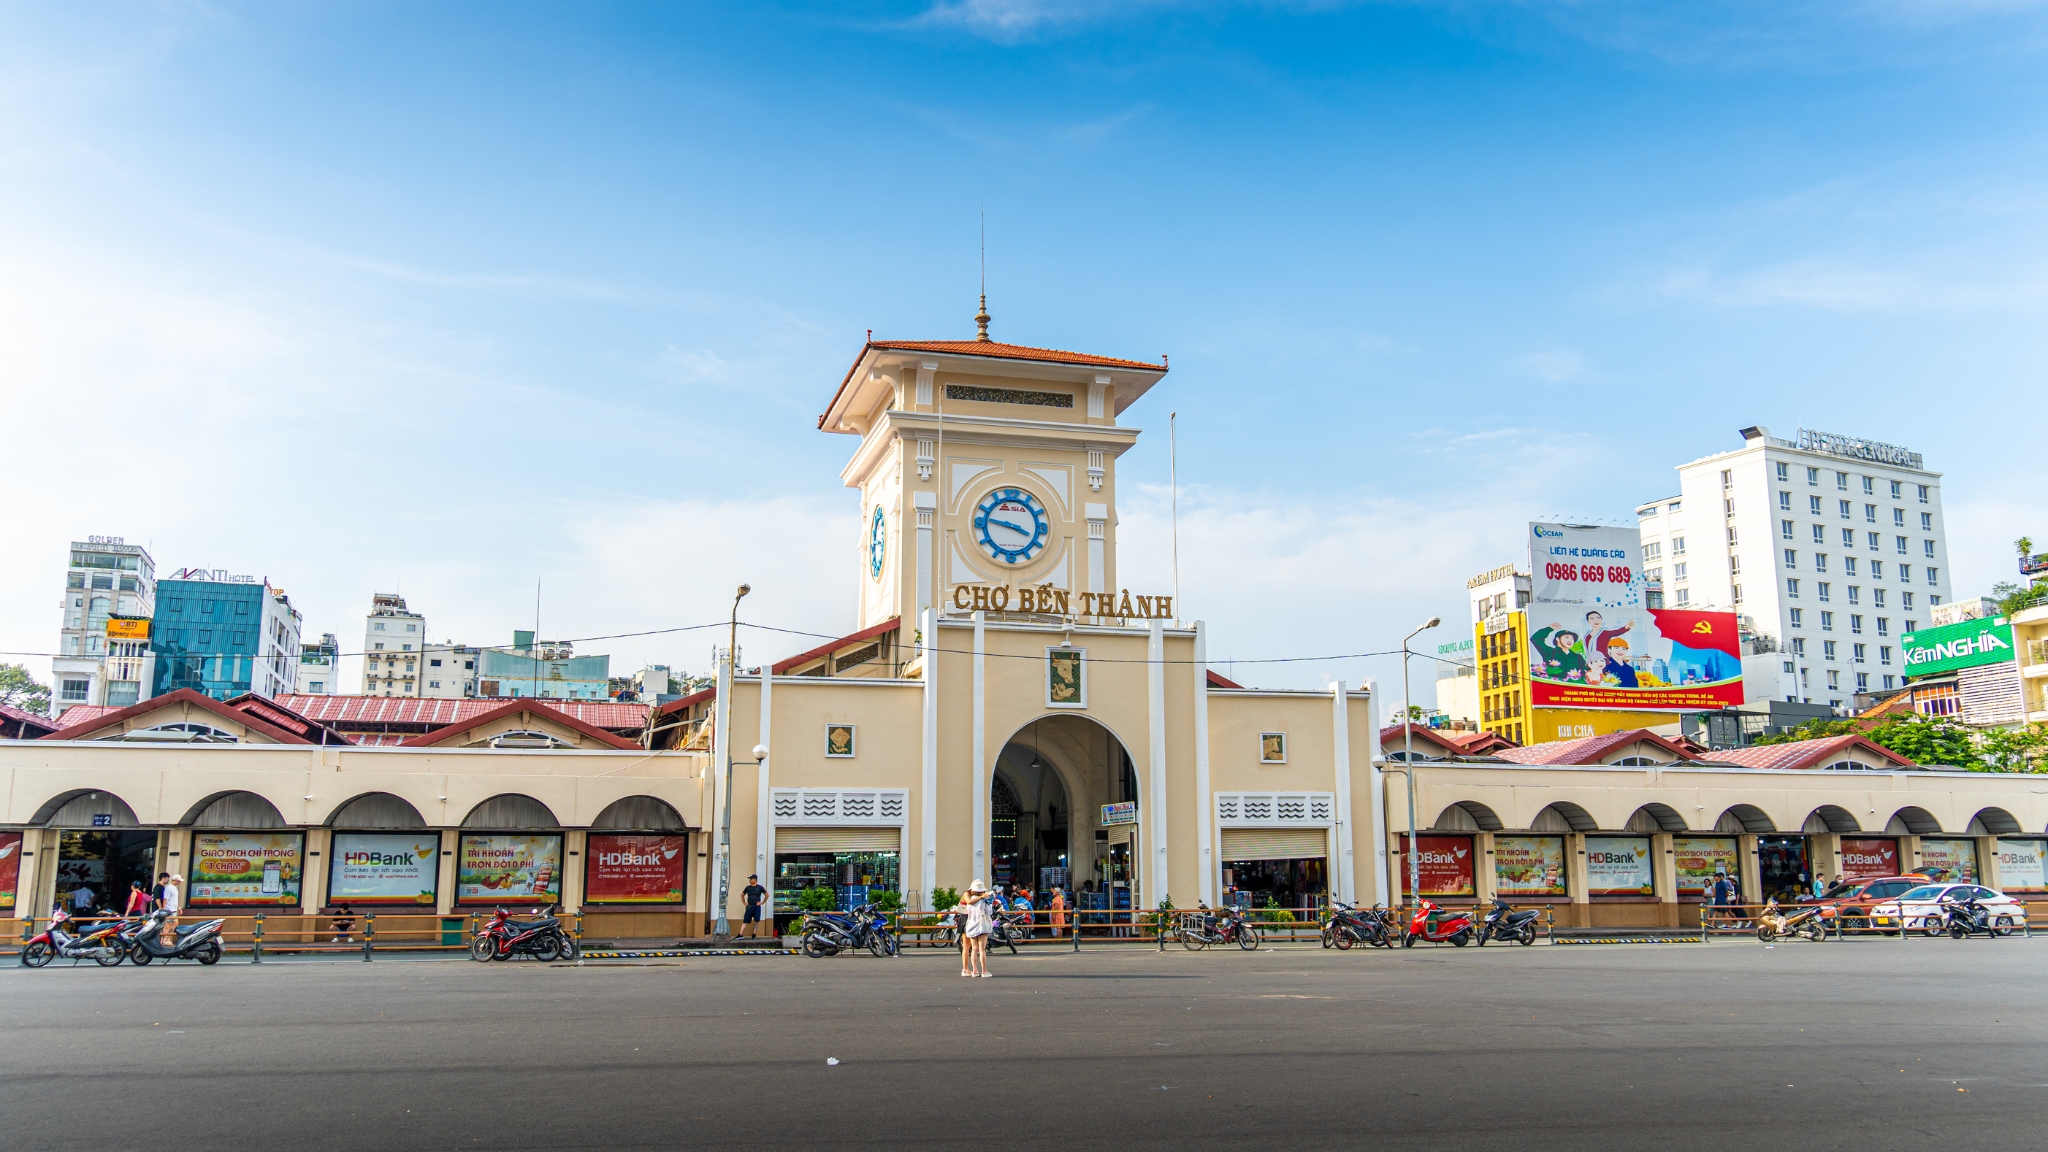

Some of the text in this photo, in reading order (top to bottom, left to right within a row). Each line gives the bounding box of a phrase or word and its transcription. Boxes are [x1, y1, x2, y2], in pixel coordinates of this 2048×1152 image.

[1854, 437, 1914, 467] CENTRAL
[1004, 488, 1020, 500] 12
[974, 516, 986, 528] 9
[1039, 522, 1048, 534] 3
[88, 535, 124, 545] GOLDEN
[1542, 530, 1563, 538] OCEAN
[1006, 552, 1016, 563] 6
[1550, 546, 1625, 558] LIÊN HỆ QUẢNG CÁO
[168, 568, 228, 582] AVANTI
[1490, 564, 1515, 582] HOTEL
[1546, 562, 1630, 583] 0986 669 689
[953, 582, 1173, 618] CHỢ BẾN THÀNH
[104, 816, 110, 825] 2
[227, 849, 246, 858] DỊCH
[248, 847, 262, 857] CHỈ
[345, 852, 413, 865] HDBank
[467, 848, 514, 857] TÀI KHOẢN
[600, 852, 661, 865] HDBank
[1588, 852, 1635, 863] HDBank
[1842, 854, 1882, 864] HDBank
